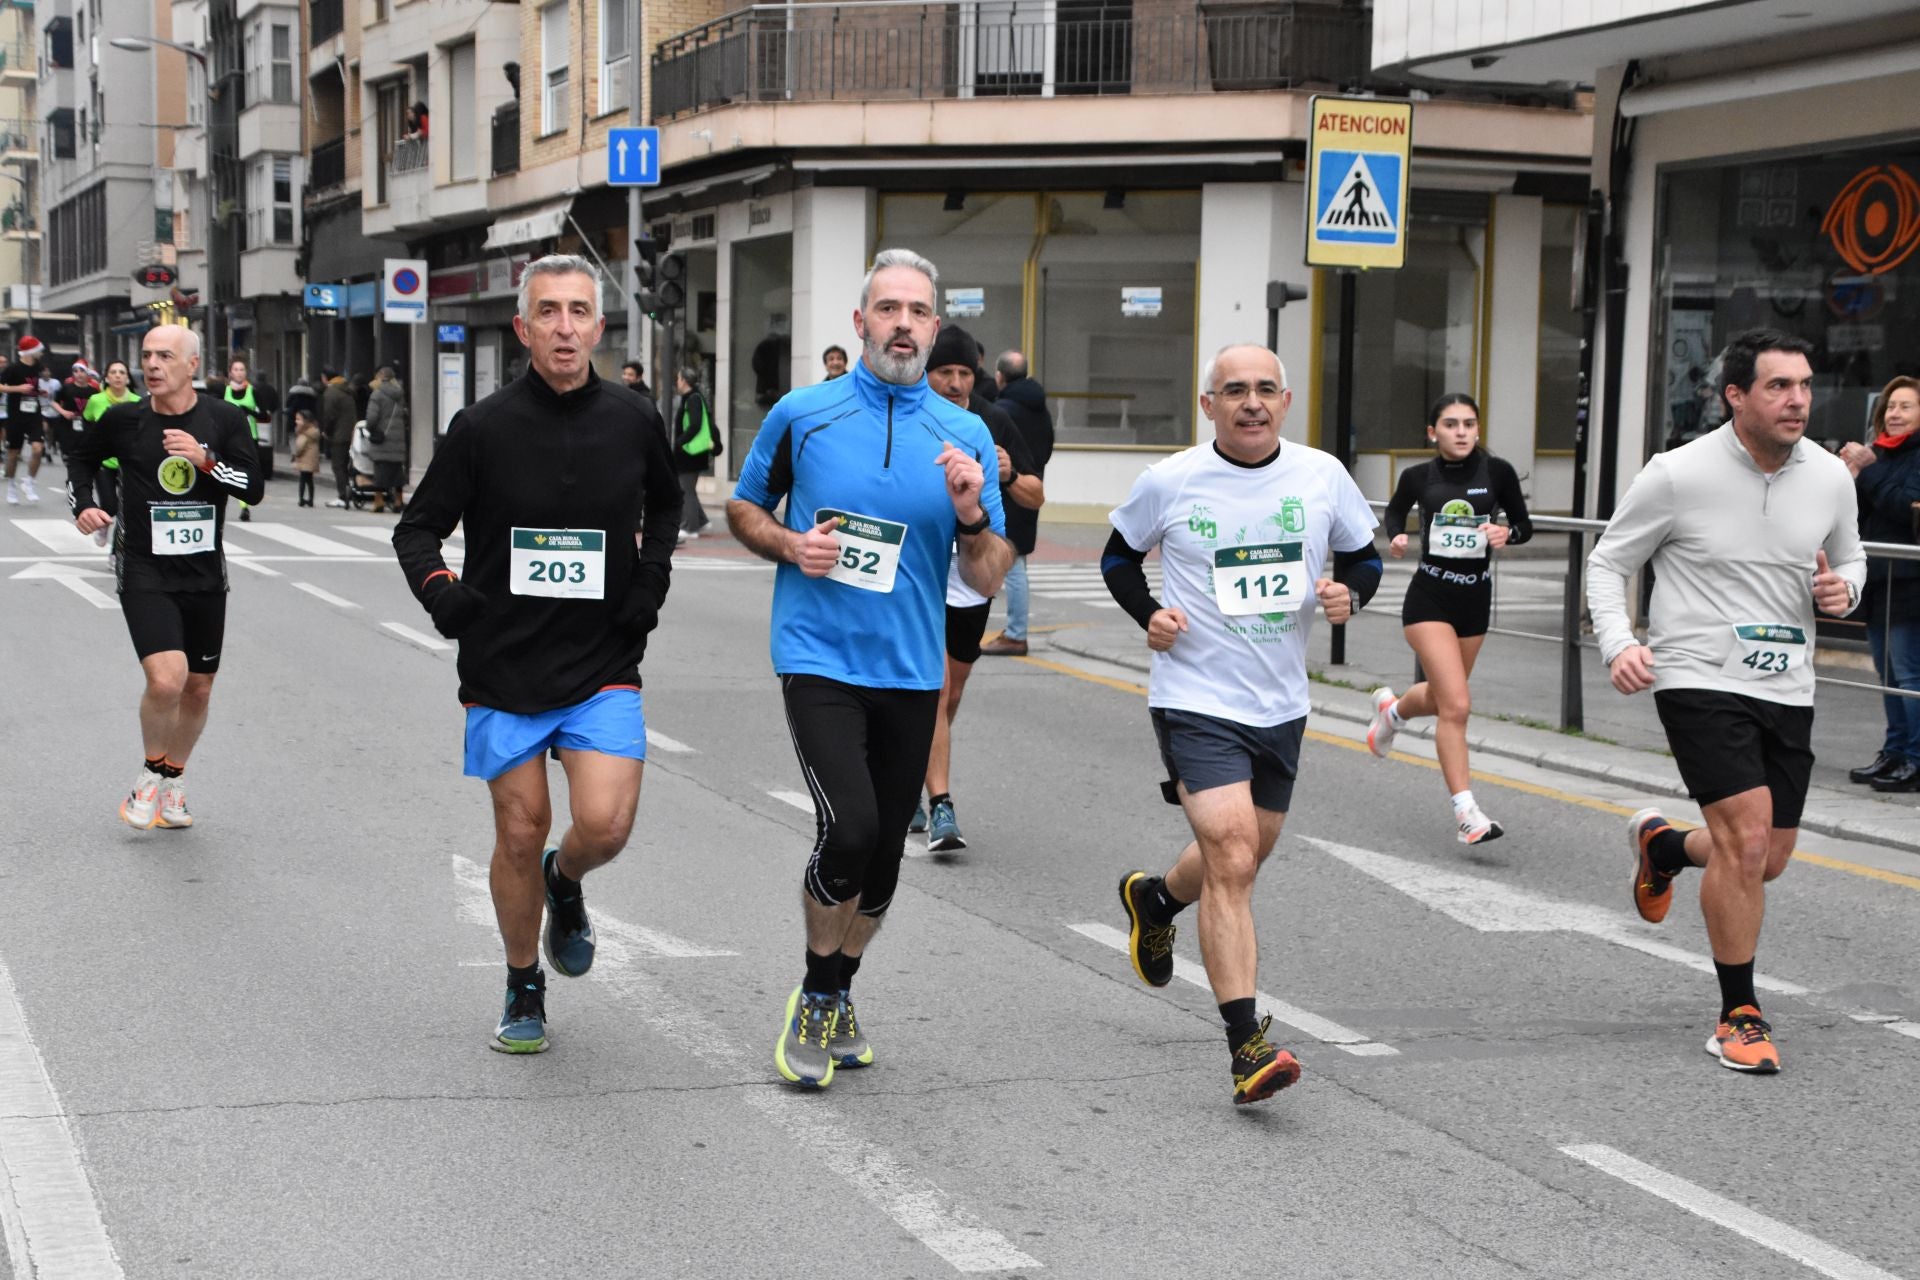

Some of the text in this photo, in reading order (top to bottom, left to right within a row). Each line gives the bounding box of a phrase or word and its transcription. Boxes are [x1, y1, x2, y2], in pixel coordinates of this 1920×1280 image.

[1318, 113, 1406, 135] ATENCION
[166, 528, 203, 544] 130
[1441, 532, 1477, 549] 355
[836, 545, 881, 575] 52
[528, 560, 586, 583] 203
[1442, 570, 1477, 585] PRO
[1234, 574, 1290, 599] 112
[1223, 621, 1247, 635] San
[1742, 650, 1789, 672] 423
